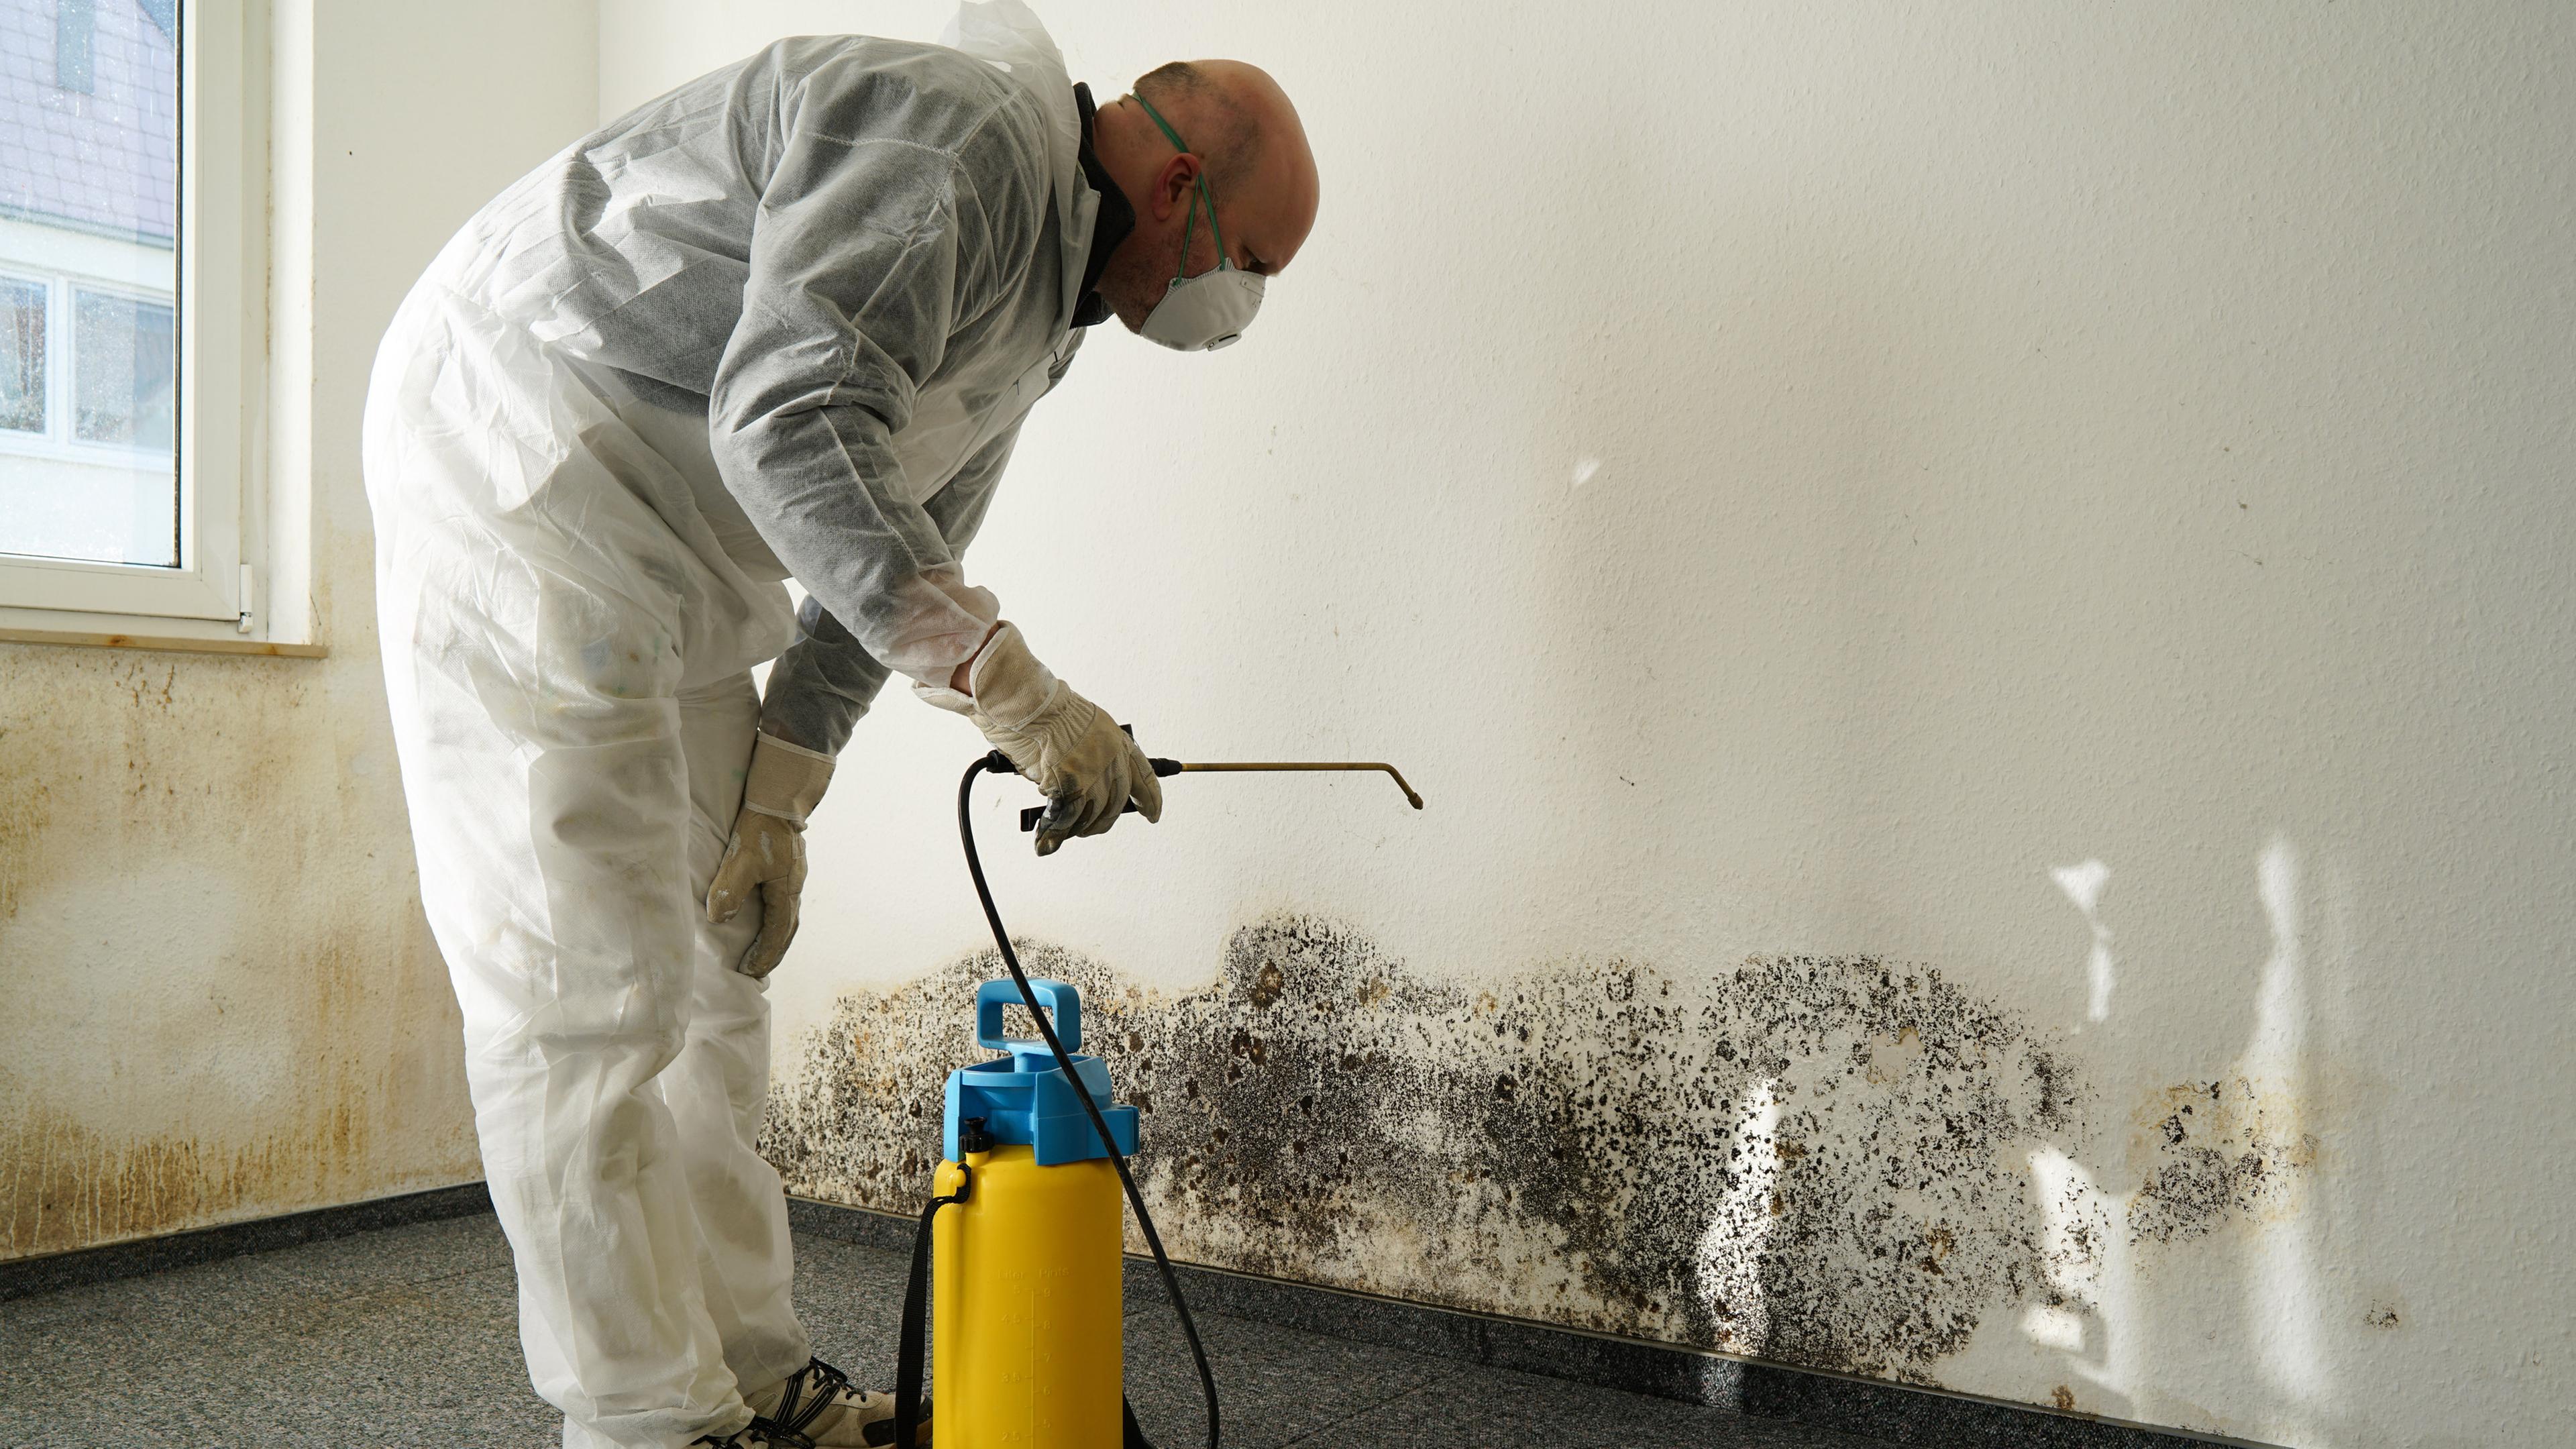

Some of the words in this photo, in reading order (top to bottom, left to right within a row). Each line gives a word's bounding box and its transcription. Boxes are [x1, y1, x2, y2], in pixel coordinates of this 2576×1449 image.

[1038, 1267, 1070, 1279] Pints
[1014, 1284, 1020, 1295] 5
[1042, 1287, 1052, 1298] 9
[1042, 1320, 1052, 1331] 8
[1043, 1352, 1052, 1363] 7
[1042, 1385, 1052, 1396] 6
[1042, 1418, 1052, 1429] 5
